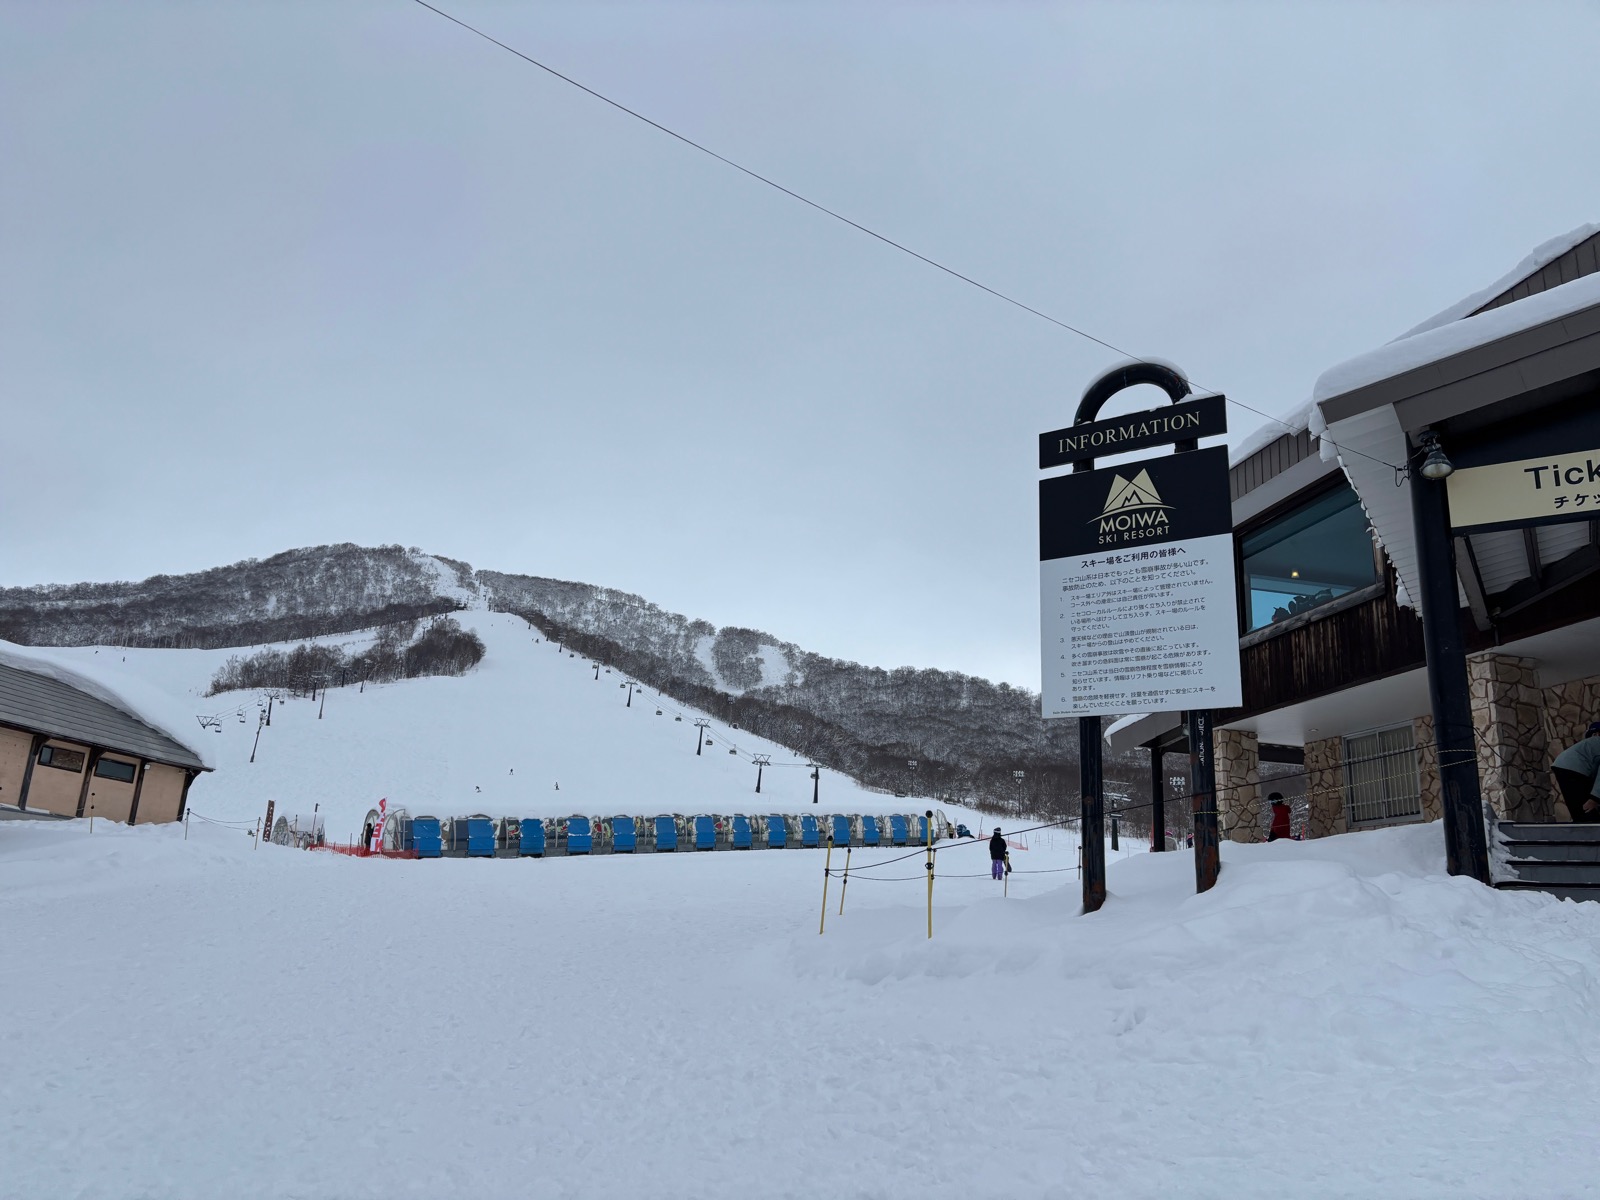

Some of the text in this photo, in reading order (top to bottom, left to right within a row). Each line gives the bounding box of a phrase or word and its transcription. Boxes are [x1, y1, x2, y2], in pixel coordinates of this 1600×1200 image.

[1058, 411, 1201, 454] INFORMATION
[1100, 509, 1169, 533] MOIWA
[1098, 525, 1170, 544] SKI RESORT
[1080, 546, 1186, 568] スキー場をご利用の皆様へ
[1071, 684, 1095, 692] あります。
